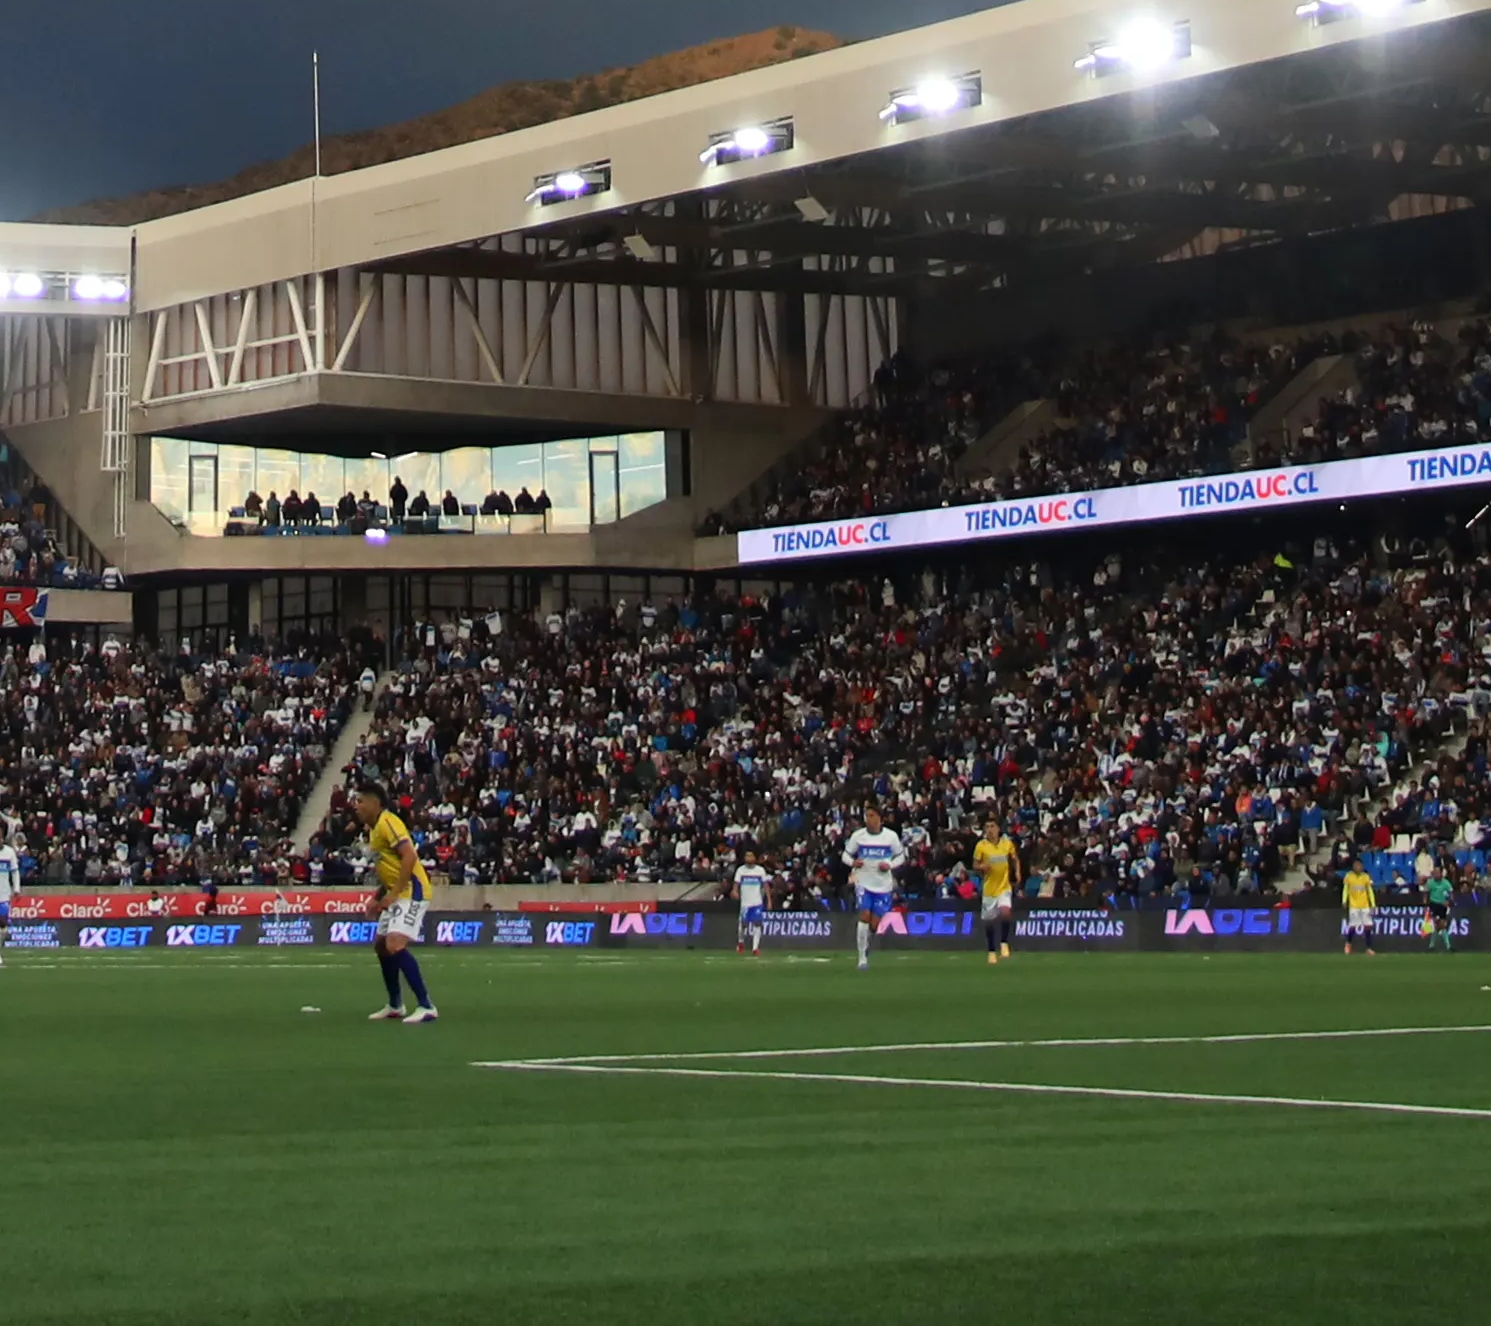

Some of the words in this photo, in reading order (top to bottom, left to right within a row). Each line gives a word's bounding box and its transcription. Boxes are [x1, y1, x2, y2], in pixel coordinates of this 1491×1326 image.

[1178, 470, 1319, 508] TIENDAUC.CL
[964, 498, 1098, 532] TIENDAUC.CL
[772, 521, 891, 553] TIENDAUC.CL
[60, 903, 104, 918] Claro
[78, 926, 153, 948] 1XBET
[165, 925, 242, 946] 1XBET
[436, 921, 484, 943] 1XBET
[545, 922, 595, 944] 1XBET
[1015, 920, 1124, 936] MULTIPLICADAS
